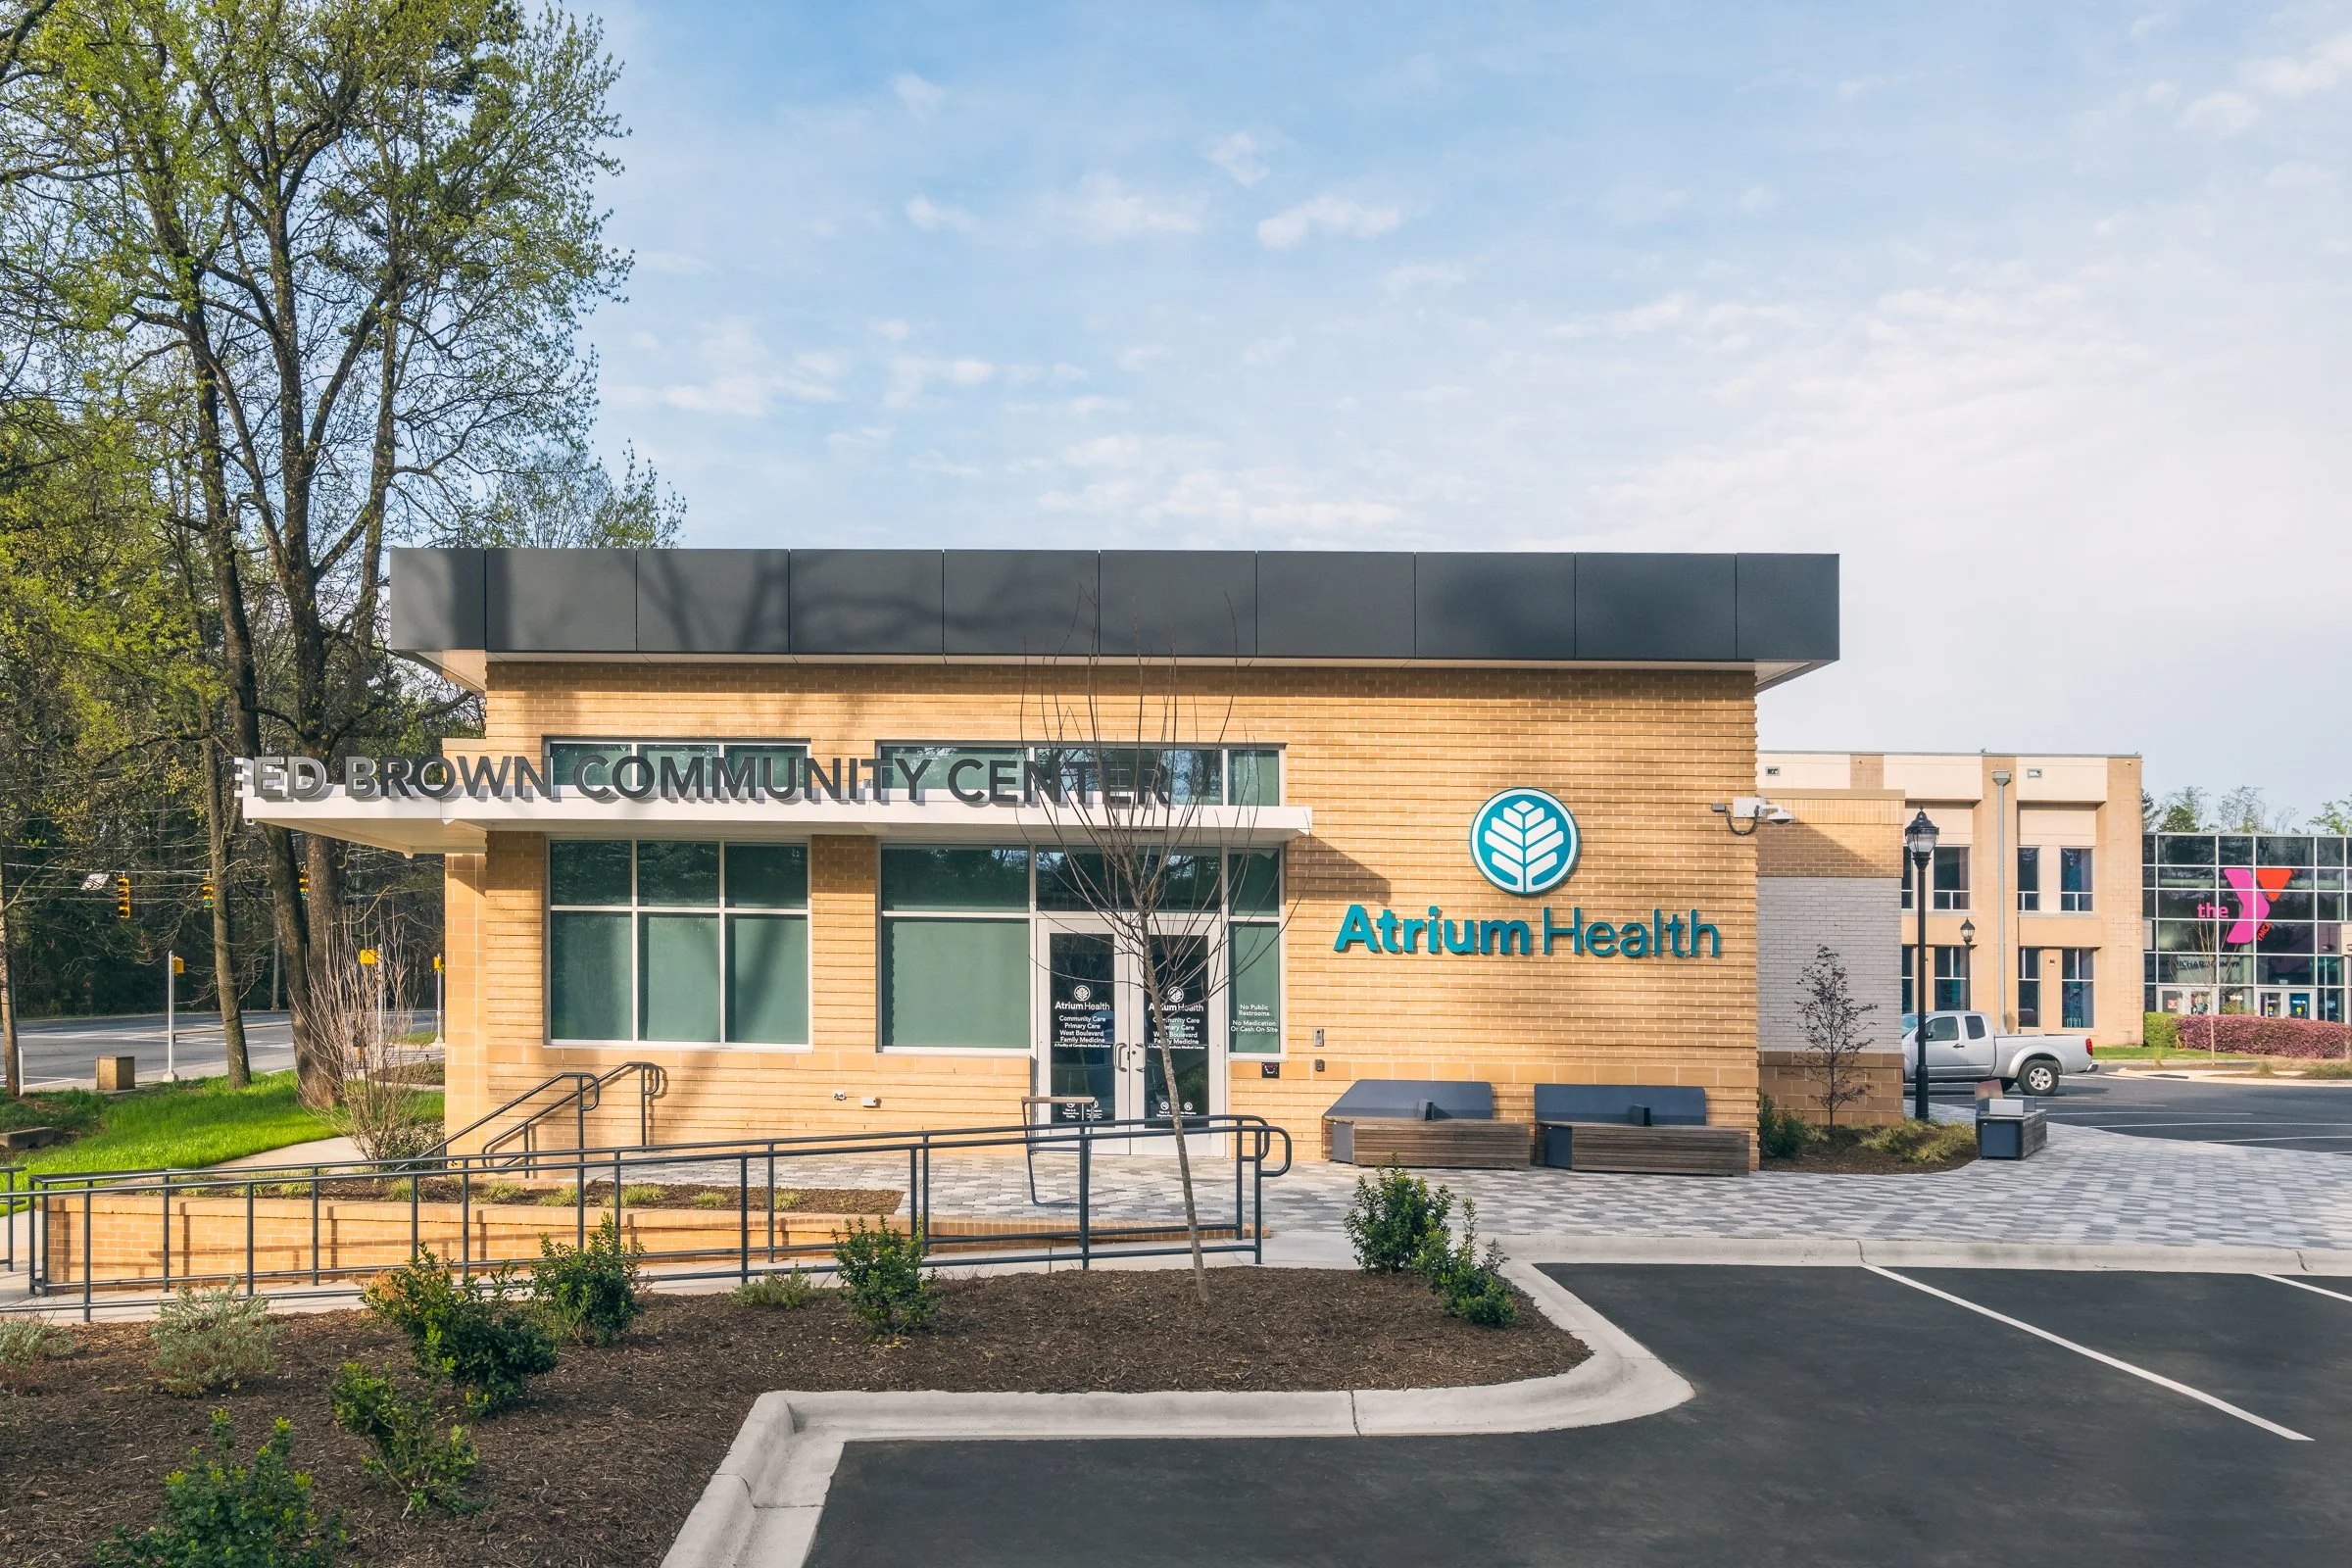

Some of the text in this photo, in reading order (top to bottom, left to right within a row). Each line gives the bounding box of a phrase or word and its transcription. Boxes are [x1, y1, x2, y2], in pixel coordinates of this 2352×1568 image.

[254, 755, 1170, 805] ED BROWN COMMUNITY CENTER
[2197, 902, 2229, 918] the
[1333, 904, 1720, 957] Atrium Health
[2256, 921, 2273, 942] YMCA
[1054, 1001, 1110, 1010] Atrium Health
[1148, 1003, 1204, 1012] Aium Health
